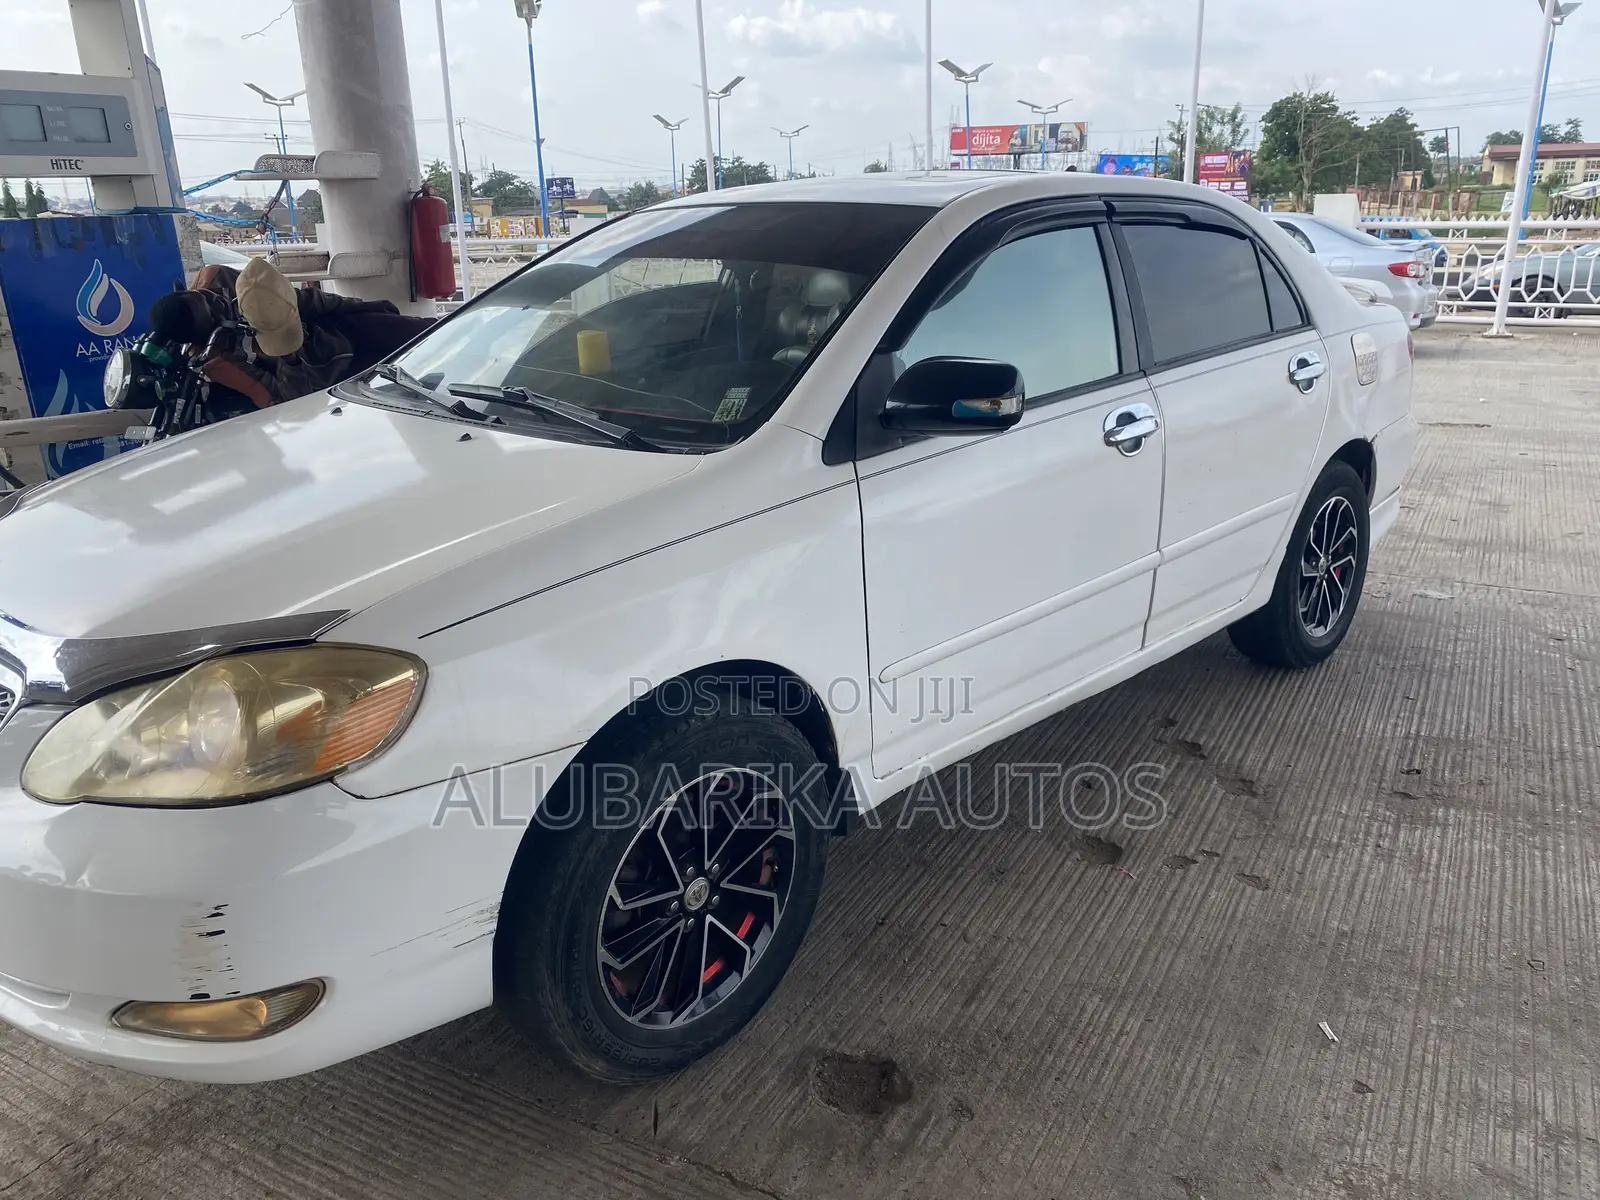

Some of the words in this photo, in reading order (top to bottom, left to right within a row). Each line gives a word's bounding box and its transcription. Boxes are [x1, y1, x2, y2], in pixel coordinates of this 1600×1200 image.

[76, 341, 101, 357] AA
[103, 336, 136, 353] RAN
[68, 440, 91, 450] Email:
